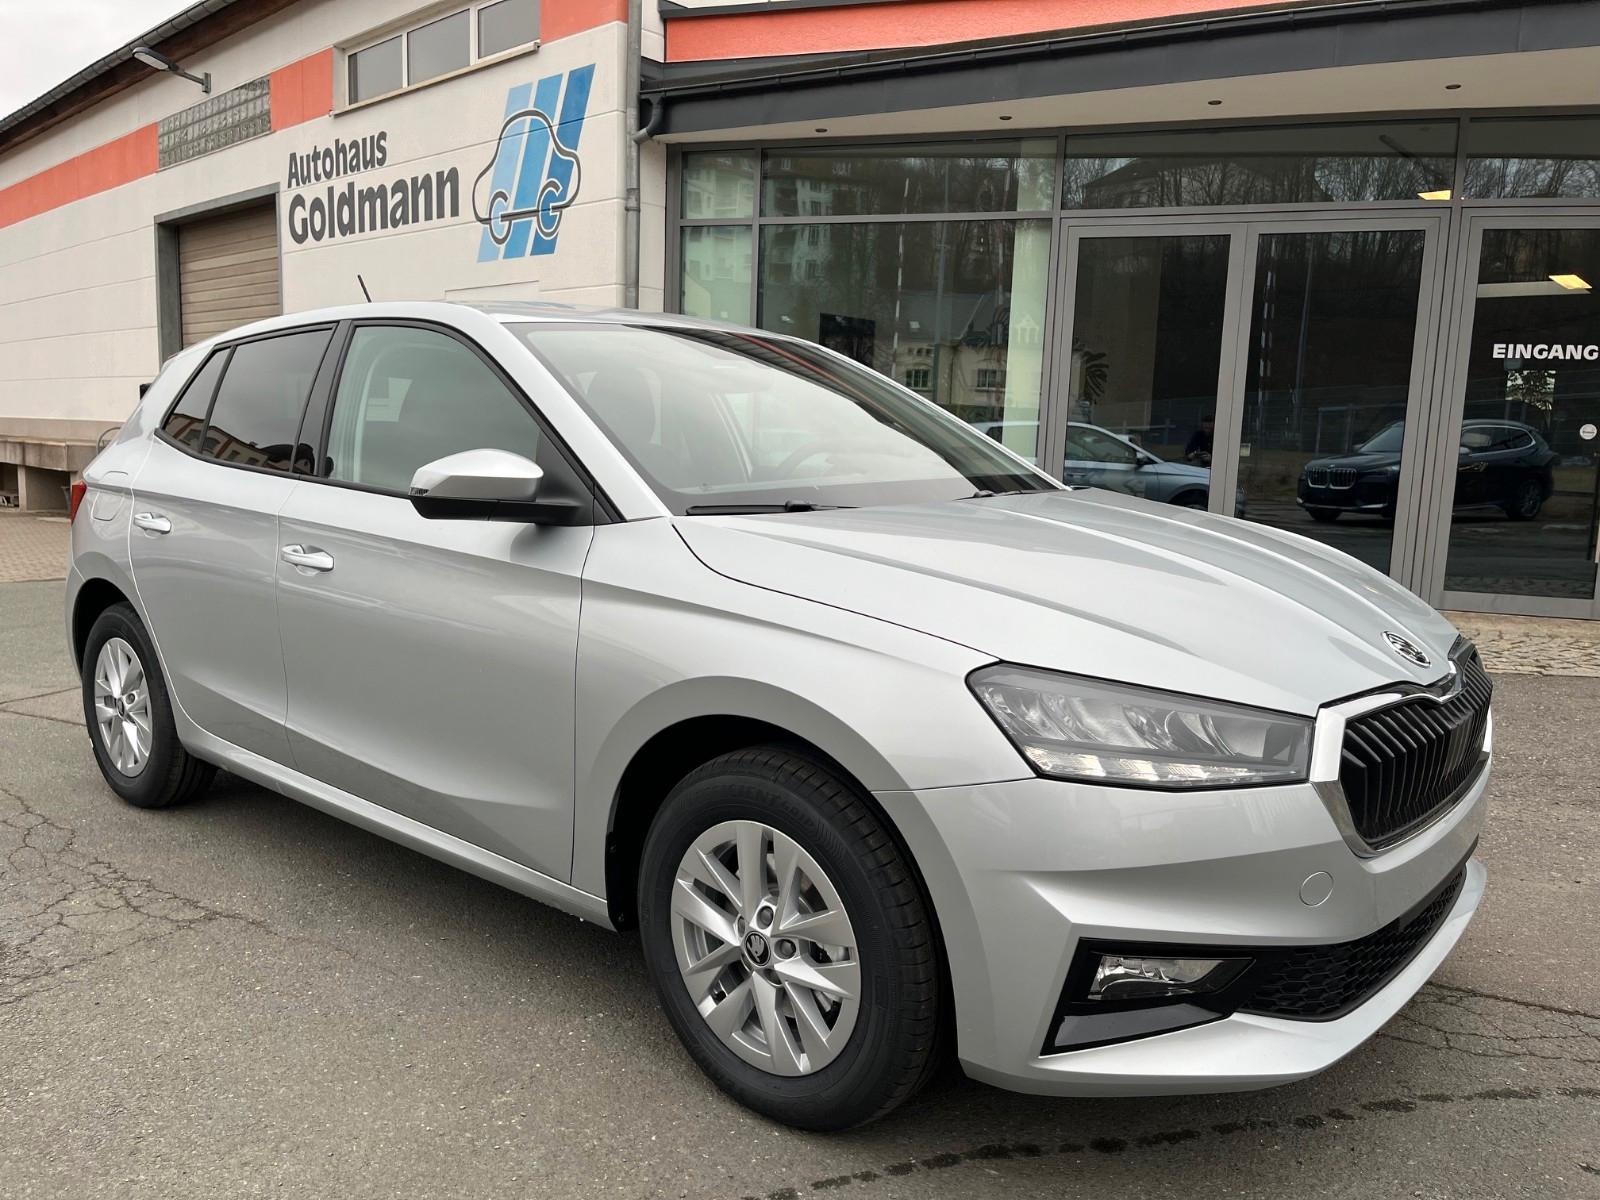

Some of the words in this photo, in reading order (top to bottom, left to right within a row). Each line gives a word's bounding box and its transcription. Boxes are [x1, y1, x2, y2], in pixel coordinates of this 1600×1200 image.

[287, 131, 387, 188] Autohaus
[288, 166, 460, 244] Goldmann
[1492, 343, 1599, 360] EINGANG
